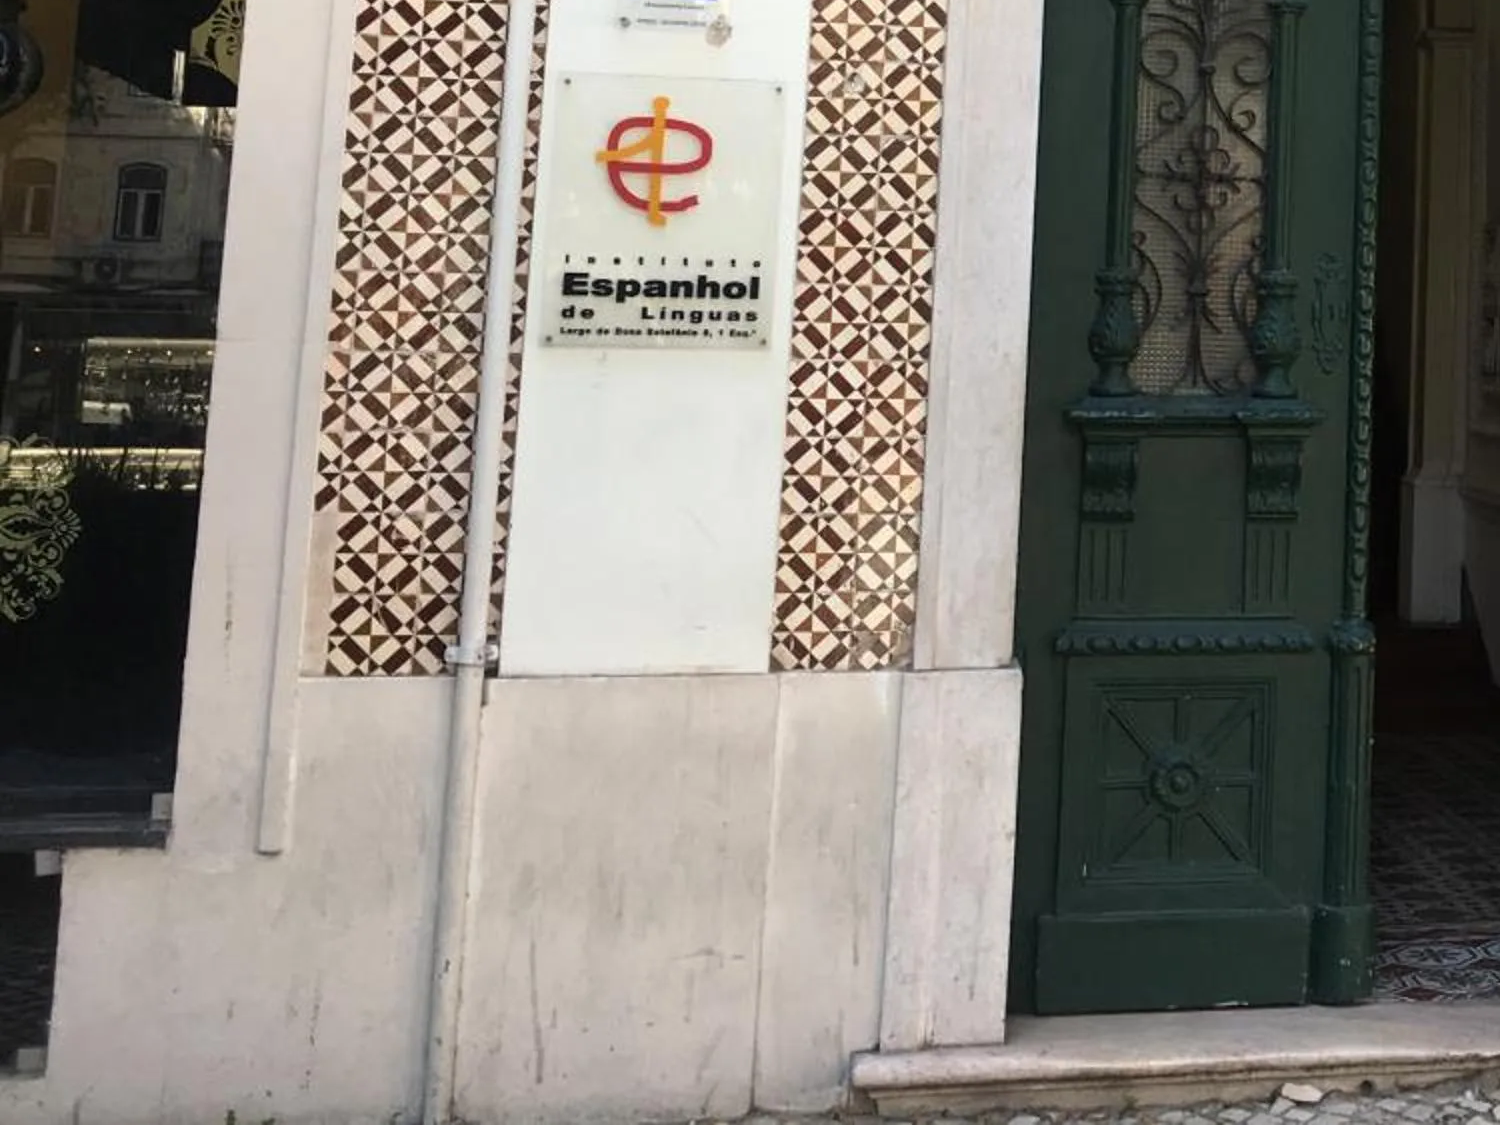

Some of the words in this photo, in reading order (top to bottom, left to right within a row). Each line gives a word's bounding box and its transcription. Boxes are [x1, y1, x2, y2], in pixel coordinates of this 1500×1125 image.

[564, 254, 761, 268] Instituto
[561, 272, 760, 303] Espanhol
[561, 305, 595, 319] de
